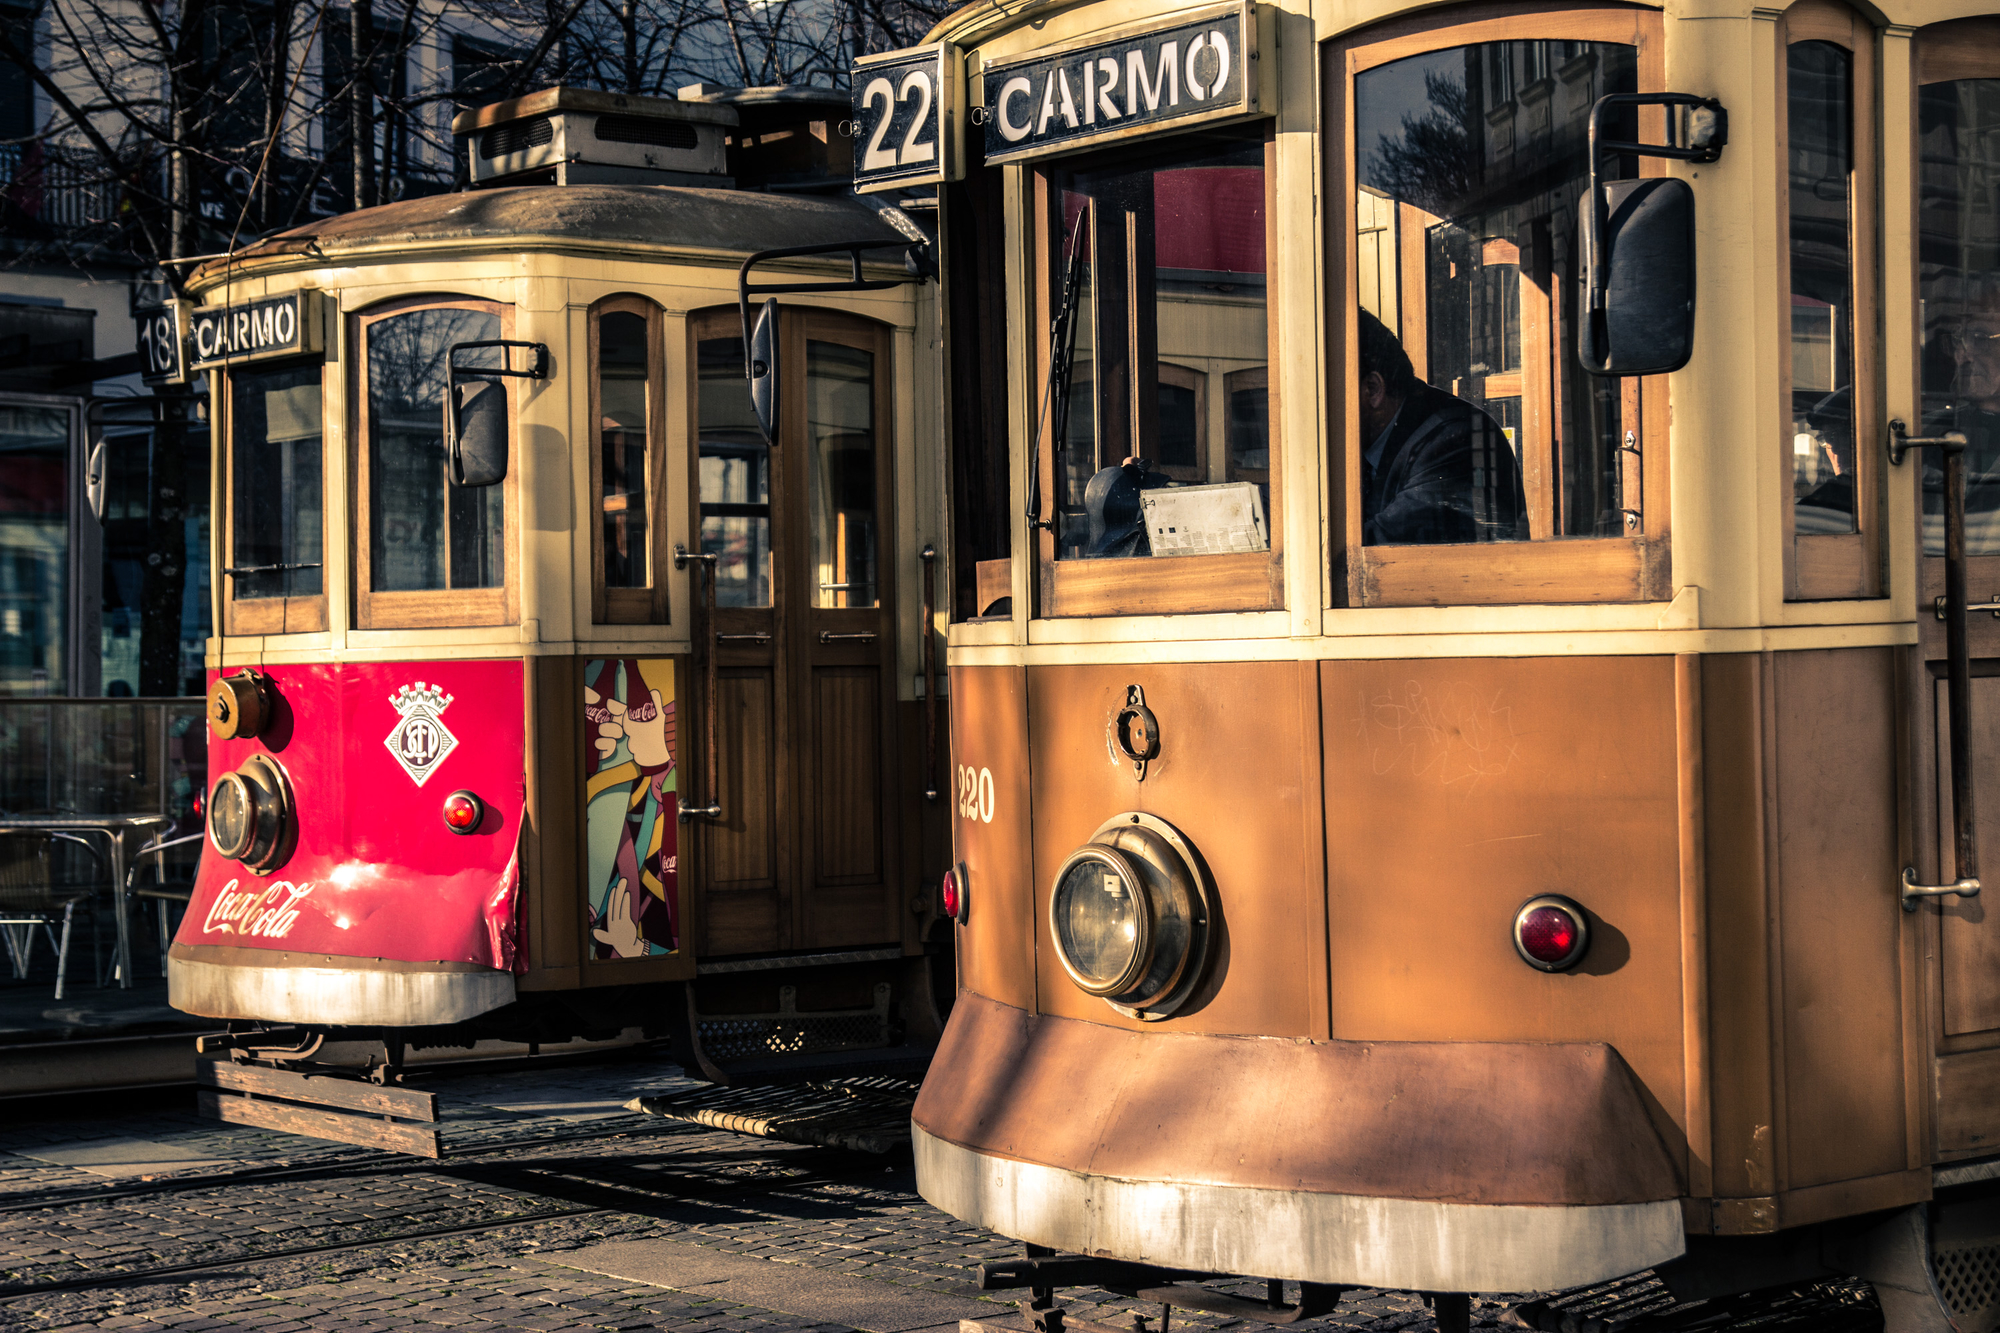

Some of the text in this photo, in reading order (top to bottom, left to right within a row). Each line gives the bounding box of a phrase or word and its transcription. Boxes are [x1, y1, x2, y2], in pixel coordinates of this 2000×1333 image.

[999, 29, 1231, 142] CARMO
[862, 70, 934, 171] 22
[141, 316, 172, 372] 18
[197, 303, 295, 358] CARMO
[958, 764, 994, 823] 220
[203, 879, 316, 938] Coca-Cola
